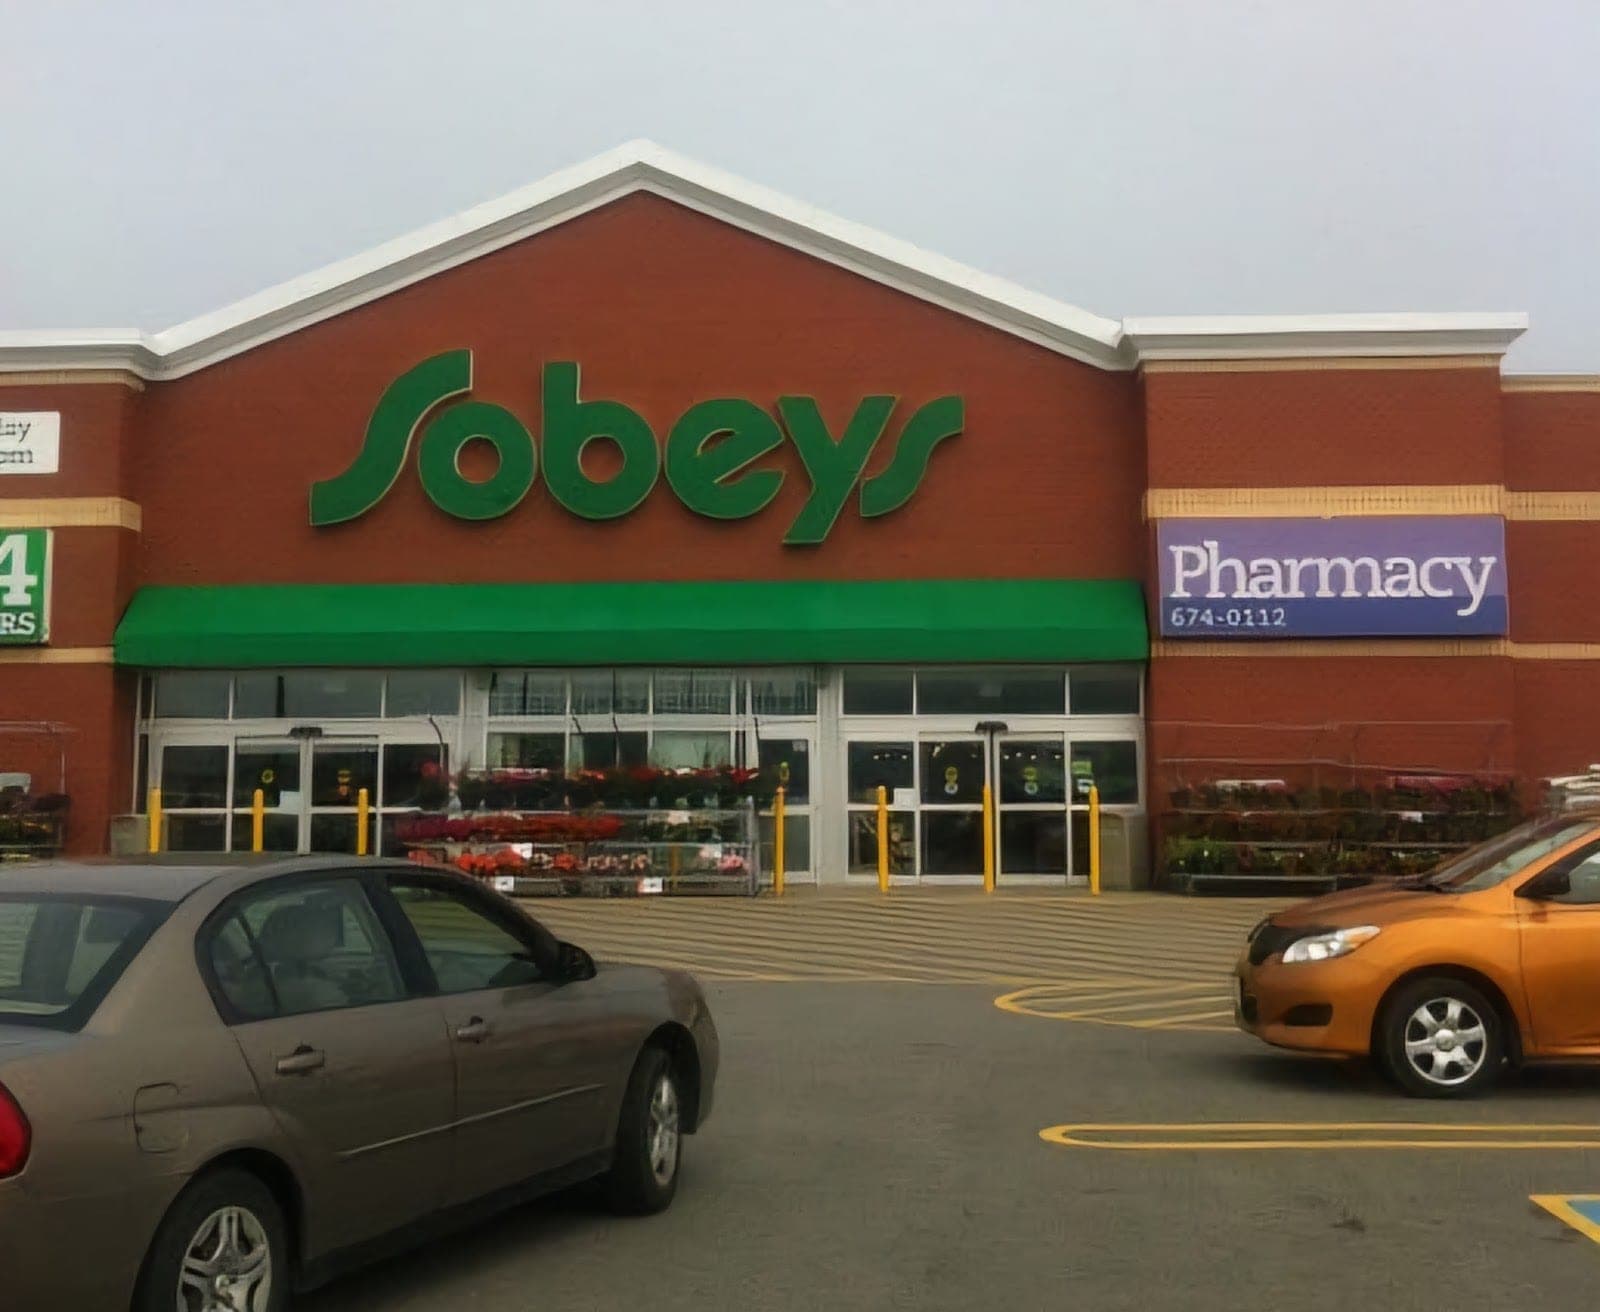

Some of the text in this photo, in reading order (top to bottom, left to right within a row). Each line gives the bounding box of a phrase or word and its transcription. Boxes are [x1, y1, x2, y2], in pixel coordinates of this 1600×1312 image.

[309, 349, 964, 544] Sobeys
[1169, 540, 1497, 616] Pharmacy
[1171, 607, 1287, 626] 674-0112
